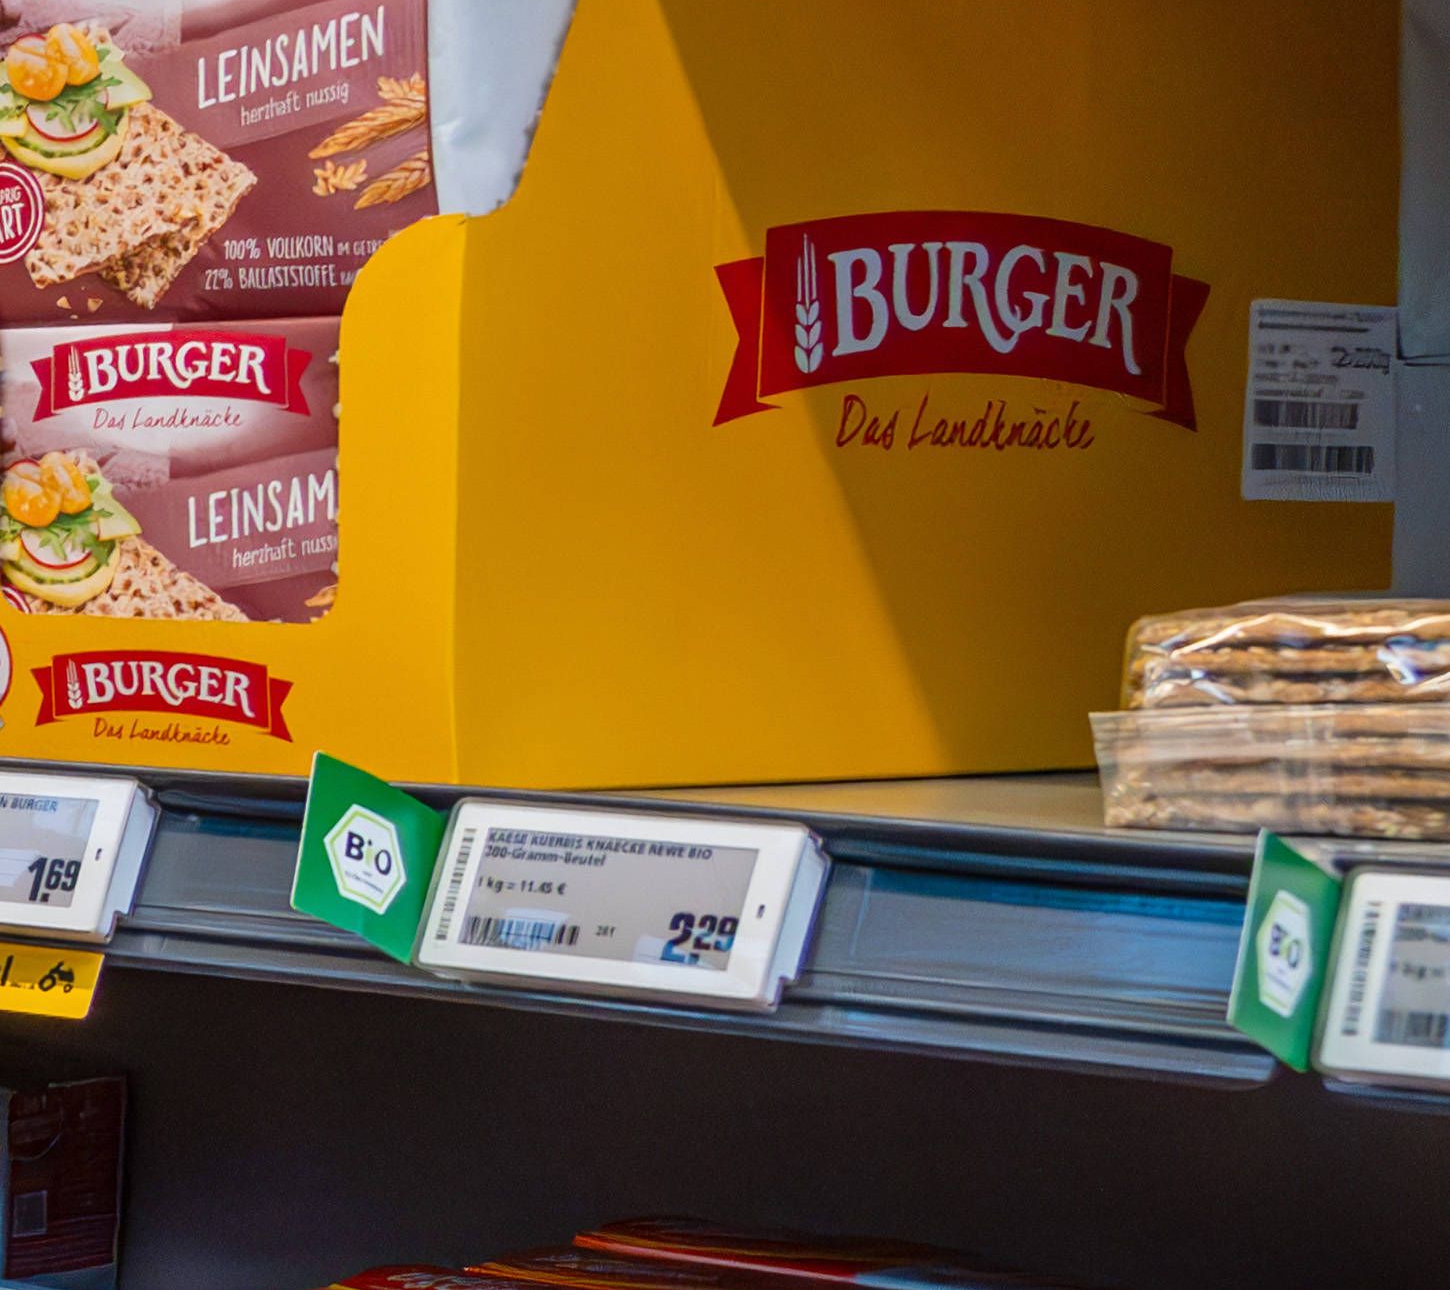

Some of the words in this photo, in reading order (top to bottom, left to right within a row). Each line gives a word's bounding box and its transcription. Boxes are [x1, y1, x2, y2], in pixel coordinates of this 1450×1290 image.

[196, 5, 386, 111] LEINSAMEN
[240, 89, 302, 127] herzhaft
[305, 80, 350, 112] nussig
[223, 237, 262, 261] 100%
[204, 268, 234, 291] 22%
[239, 260, 337, 289] BALLASTSTOFFE
[828, 240, 1143, 376] BURGER
[836, 393, 900, 450] Das
[908, 392, 1096, 452] Landknäcke
[27, 855, 82, 903] 1.69
[668, 911, 739, 965] 2.29
